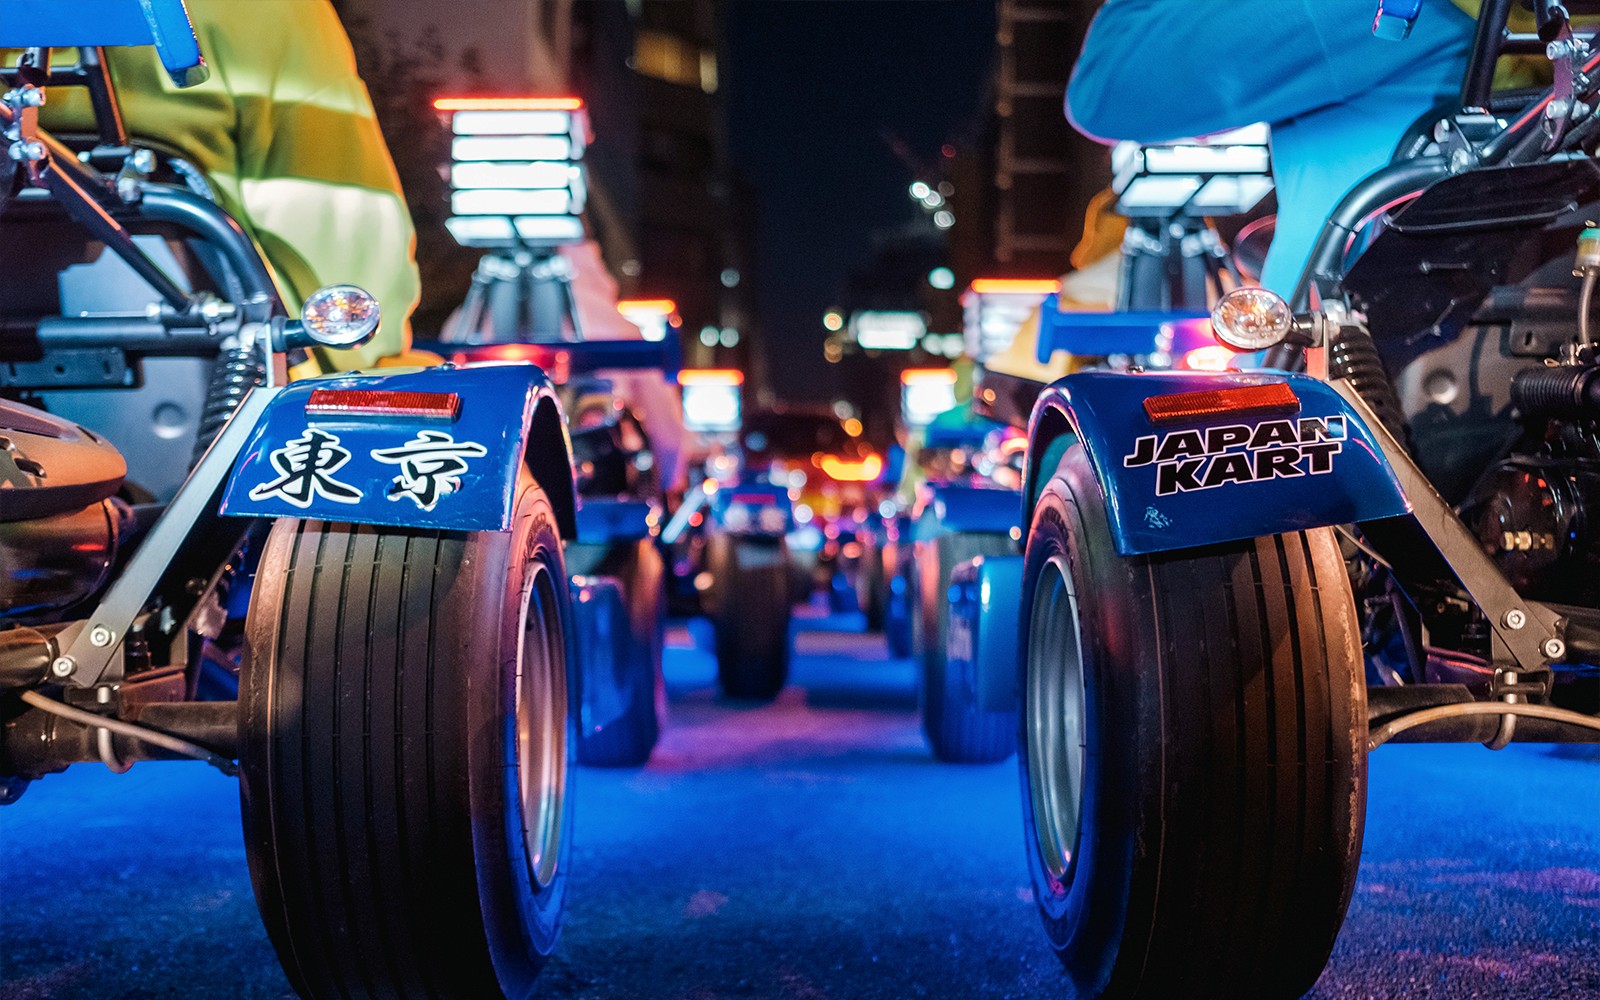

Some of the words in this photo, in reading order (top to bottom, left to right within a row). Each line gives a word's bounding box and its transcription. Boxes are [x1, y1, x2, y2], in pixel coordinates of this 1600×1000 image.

[1123, 415, 1347, 467] JAPAN
[249, 428, 487, 511] 東京
[1156, 442, 1342, 496] KART
